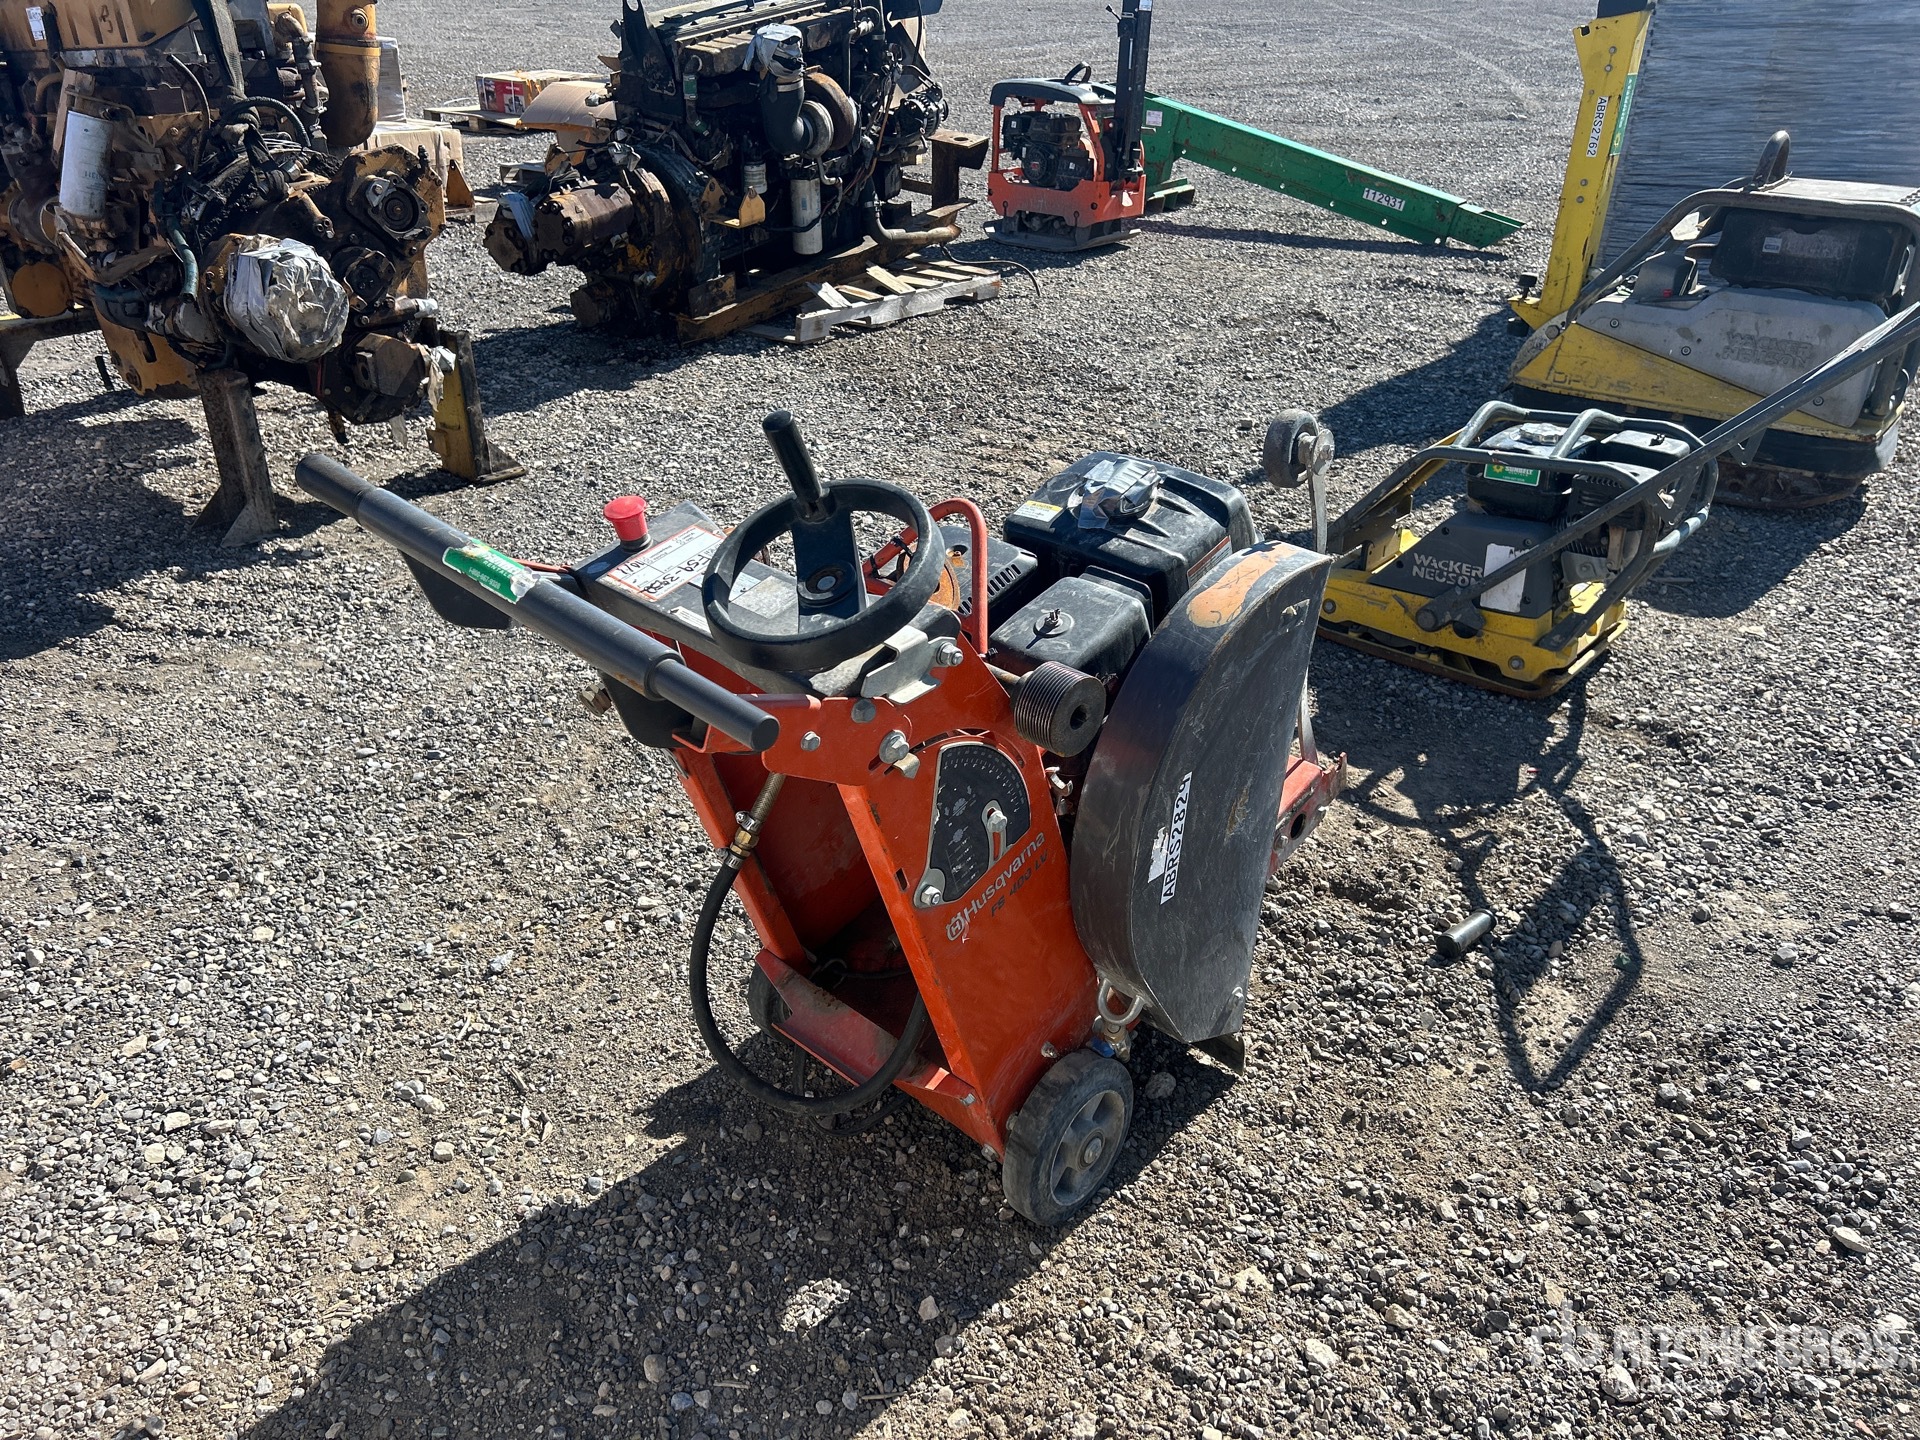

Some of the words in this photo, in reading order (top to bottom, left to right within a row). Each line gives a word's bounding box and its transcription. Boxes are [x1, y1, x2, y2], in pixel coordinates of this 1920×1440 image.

[1586, 97, 1607, 156] ABRS2762
[1365, 189, 1403, 210] 112931
[1412, 552, 1483, 578] WACKER
[1163, 777, 1190, 897] ABRS2829
[964, 831, 1046, 922] Husqvarna
